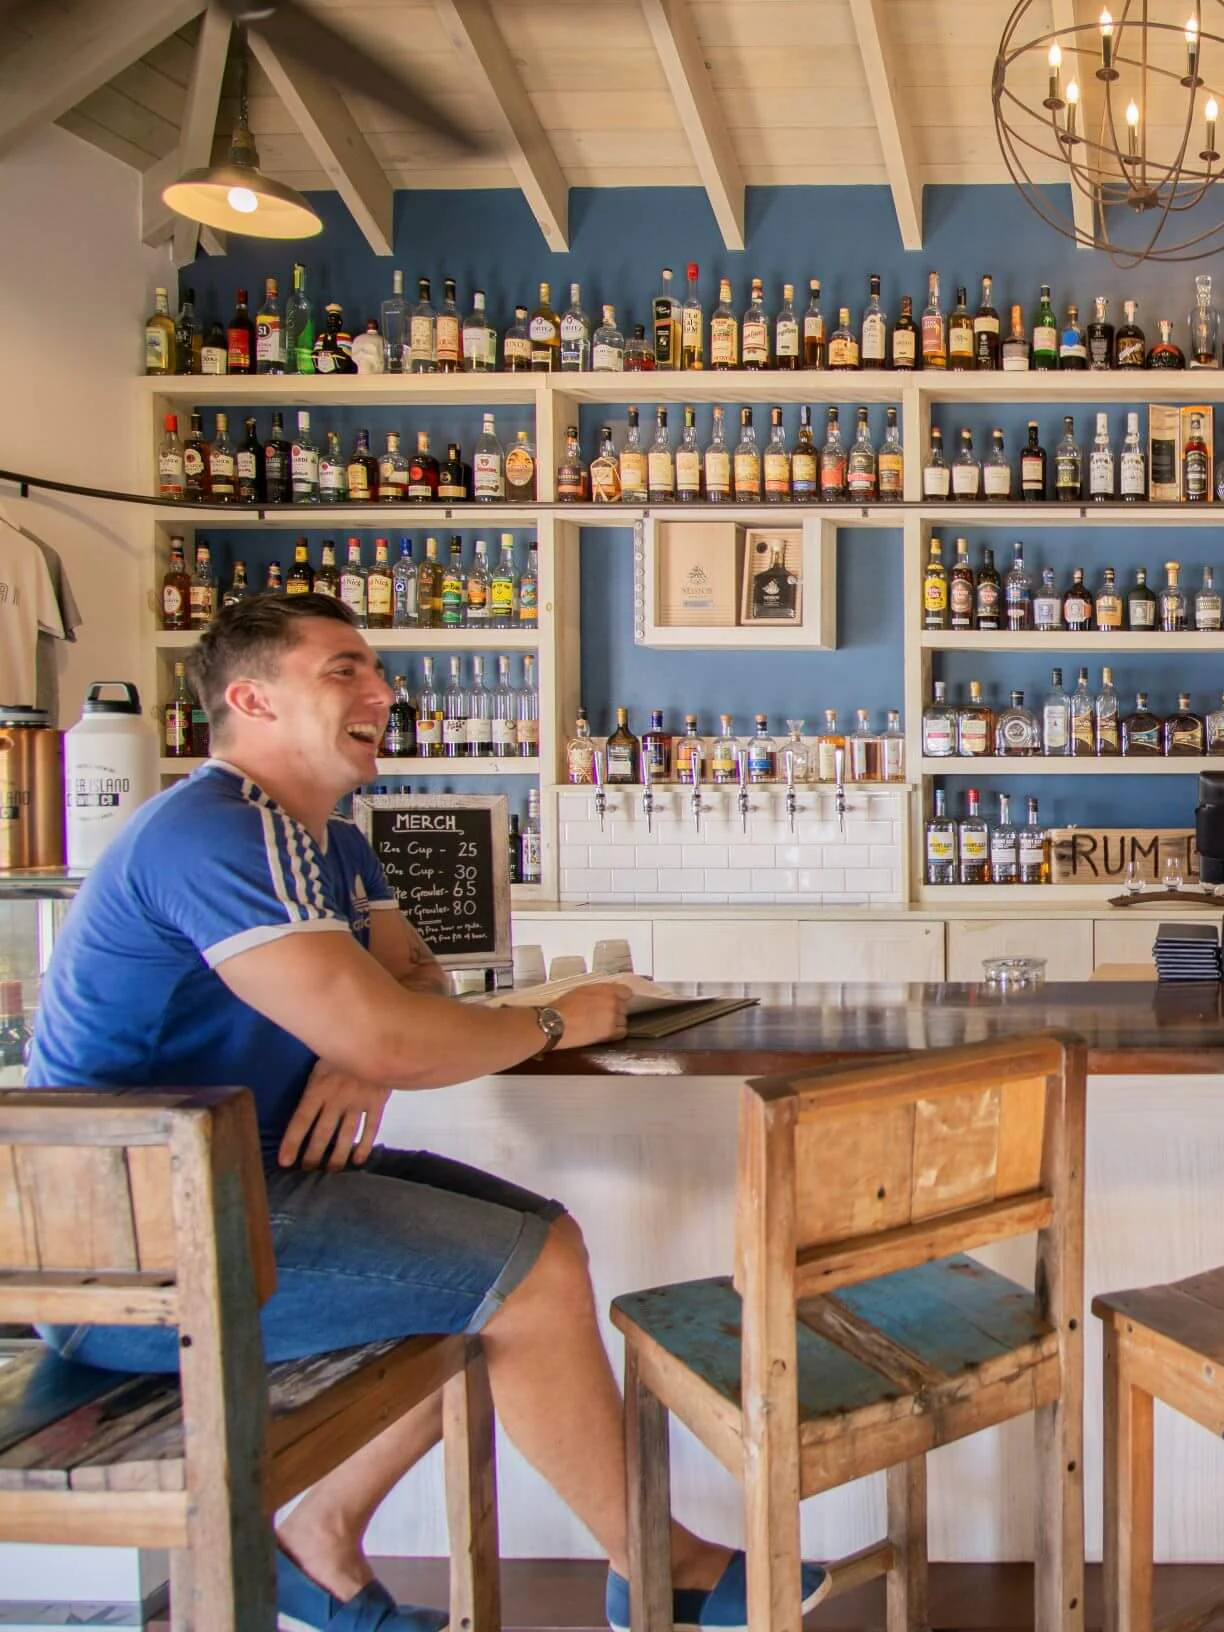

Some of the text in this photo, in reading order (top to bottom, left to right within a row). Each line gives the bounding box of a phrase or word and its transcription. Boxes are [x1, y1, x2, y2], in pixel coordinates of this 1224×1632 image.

[257, 324, 268, 336] 51
[396, 814, 456, 829] MERCH
[407, 841, 433, 859] Cup
[458, 842, 477, 857] 25
[1072, 834, 1159, 878] RUM
[409, 863, 434, 879] Cup
[454, 864, 477, 880] 30
[453, 881, 476, 896] 65
[453, 900, 477, 916] 80
